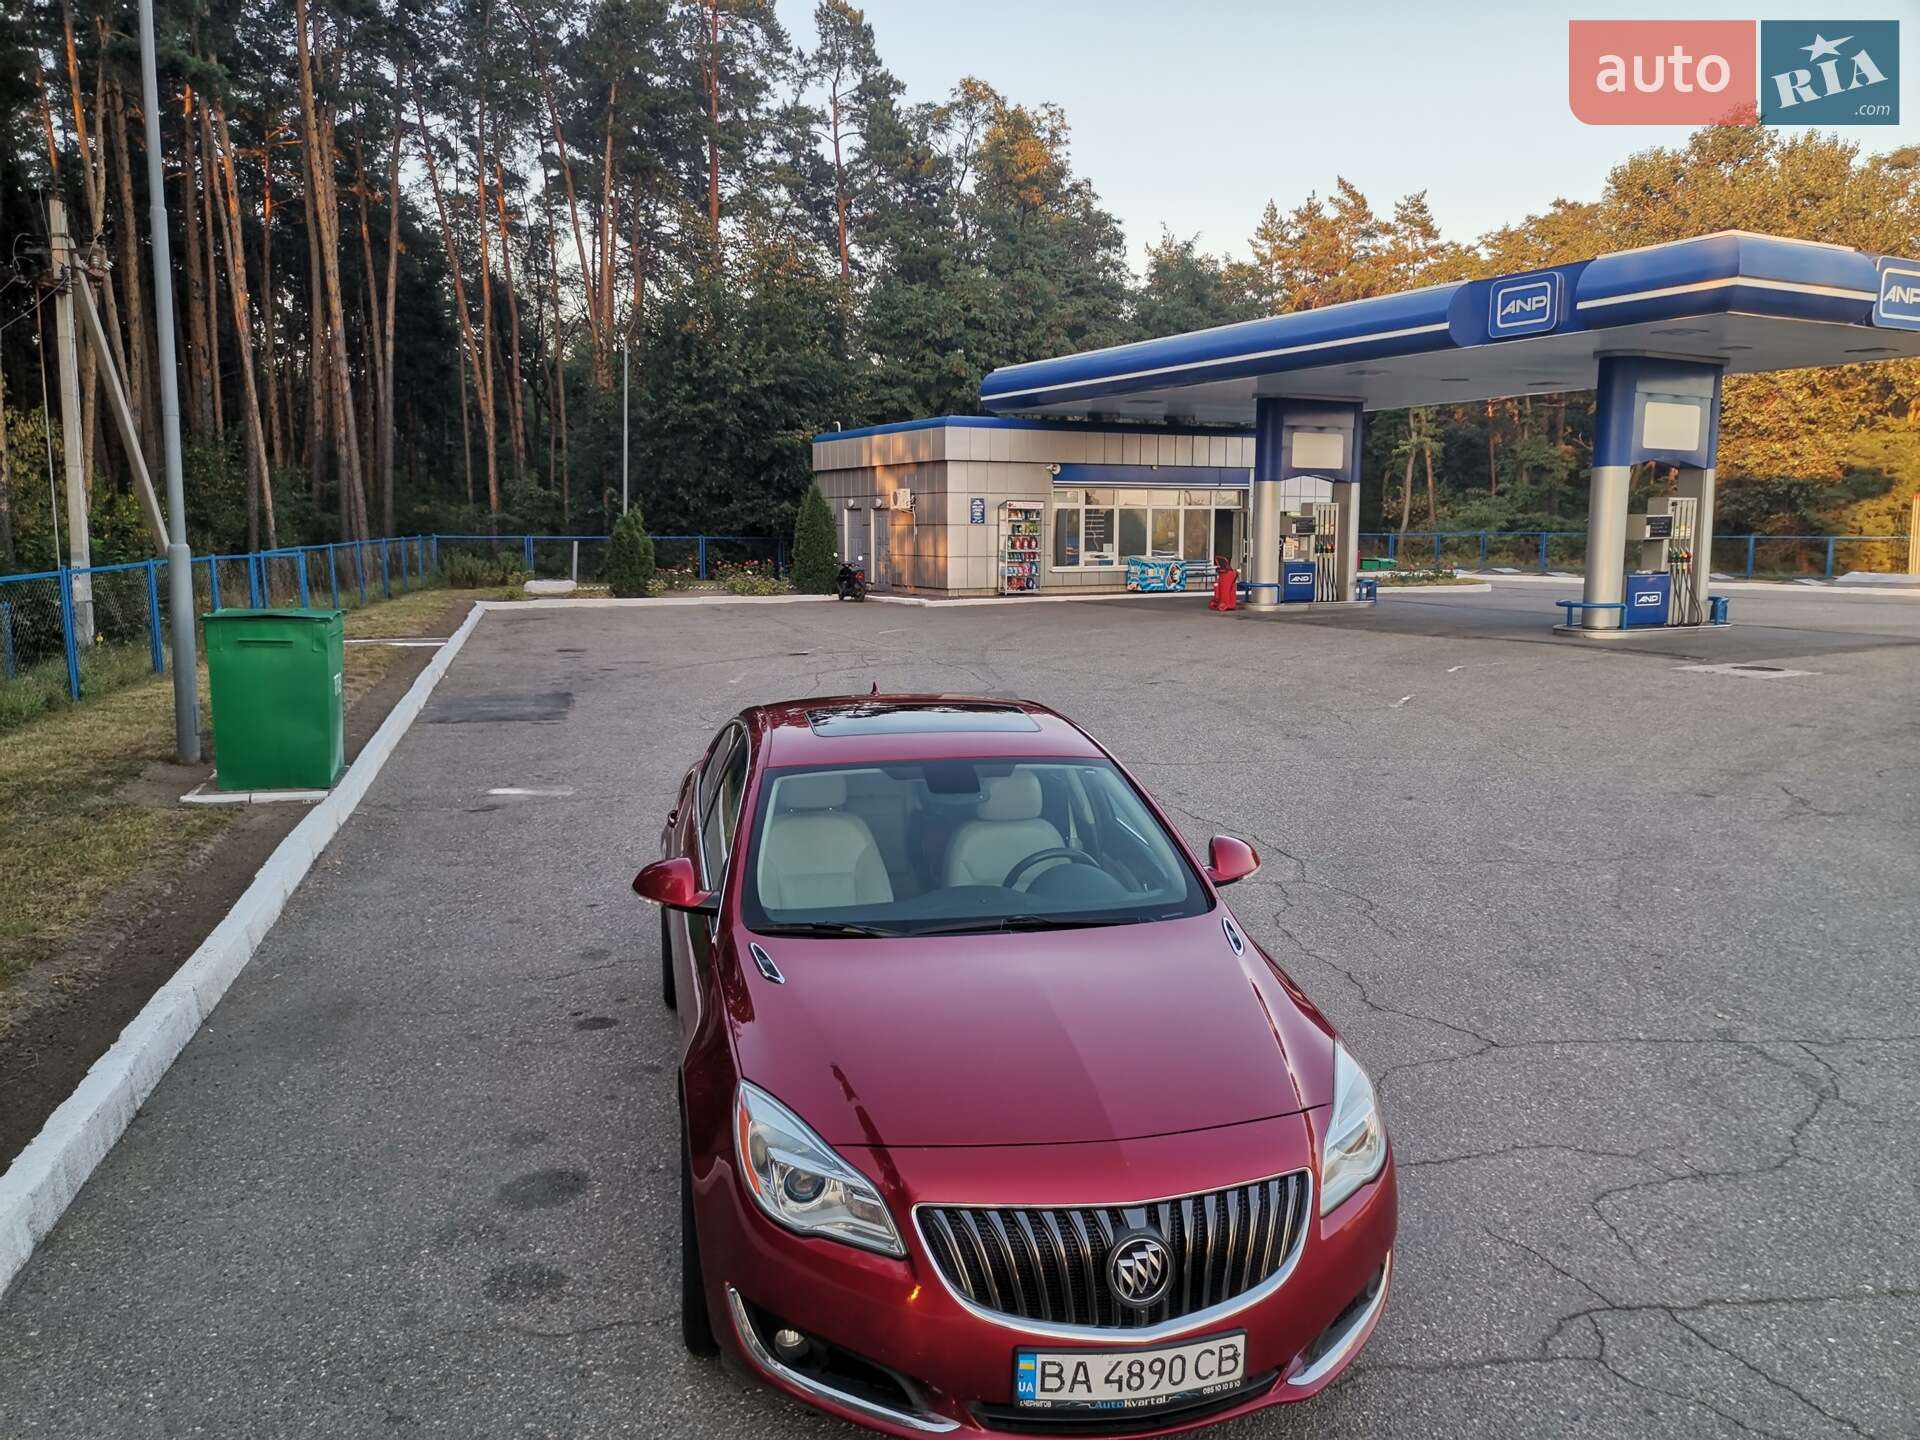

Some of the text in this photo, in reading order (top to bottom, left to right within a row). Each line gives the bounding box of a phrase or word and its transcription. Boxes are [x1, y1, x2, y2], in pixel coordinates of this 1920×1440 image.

[1501, 295, 1548, 316] ANP
[1039, 1343, 1241, 1393] BA 4890 CB
[1018, 1381, 1034, 1393] UA
